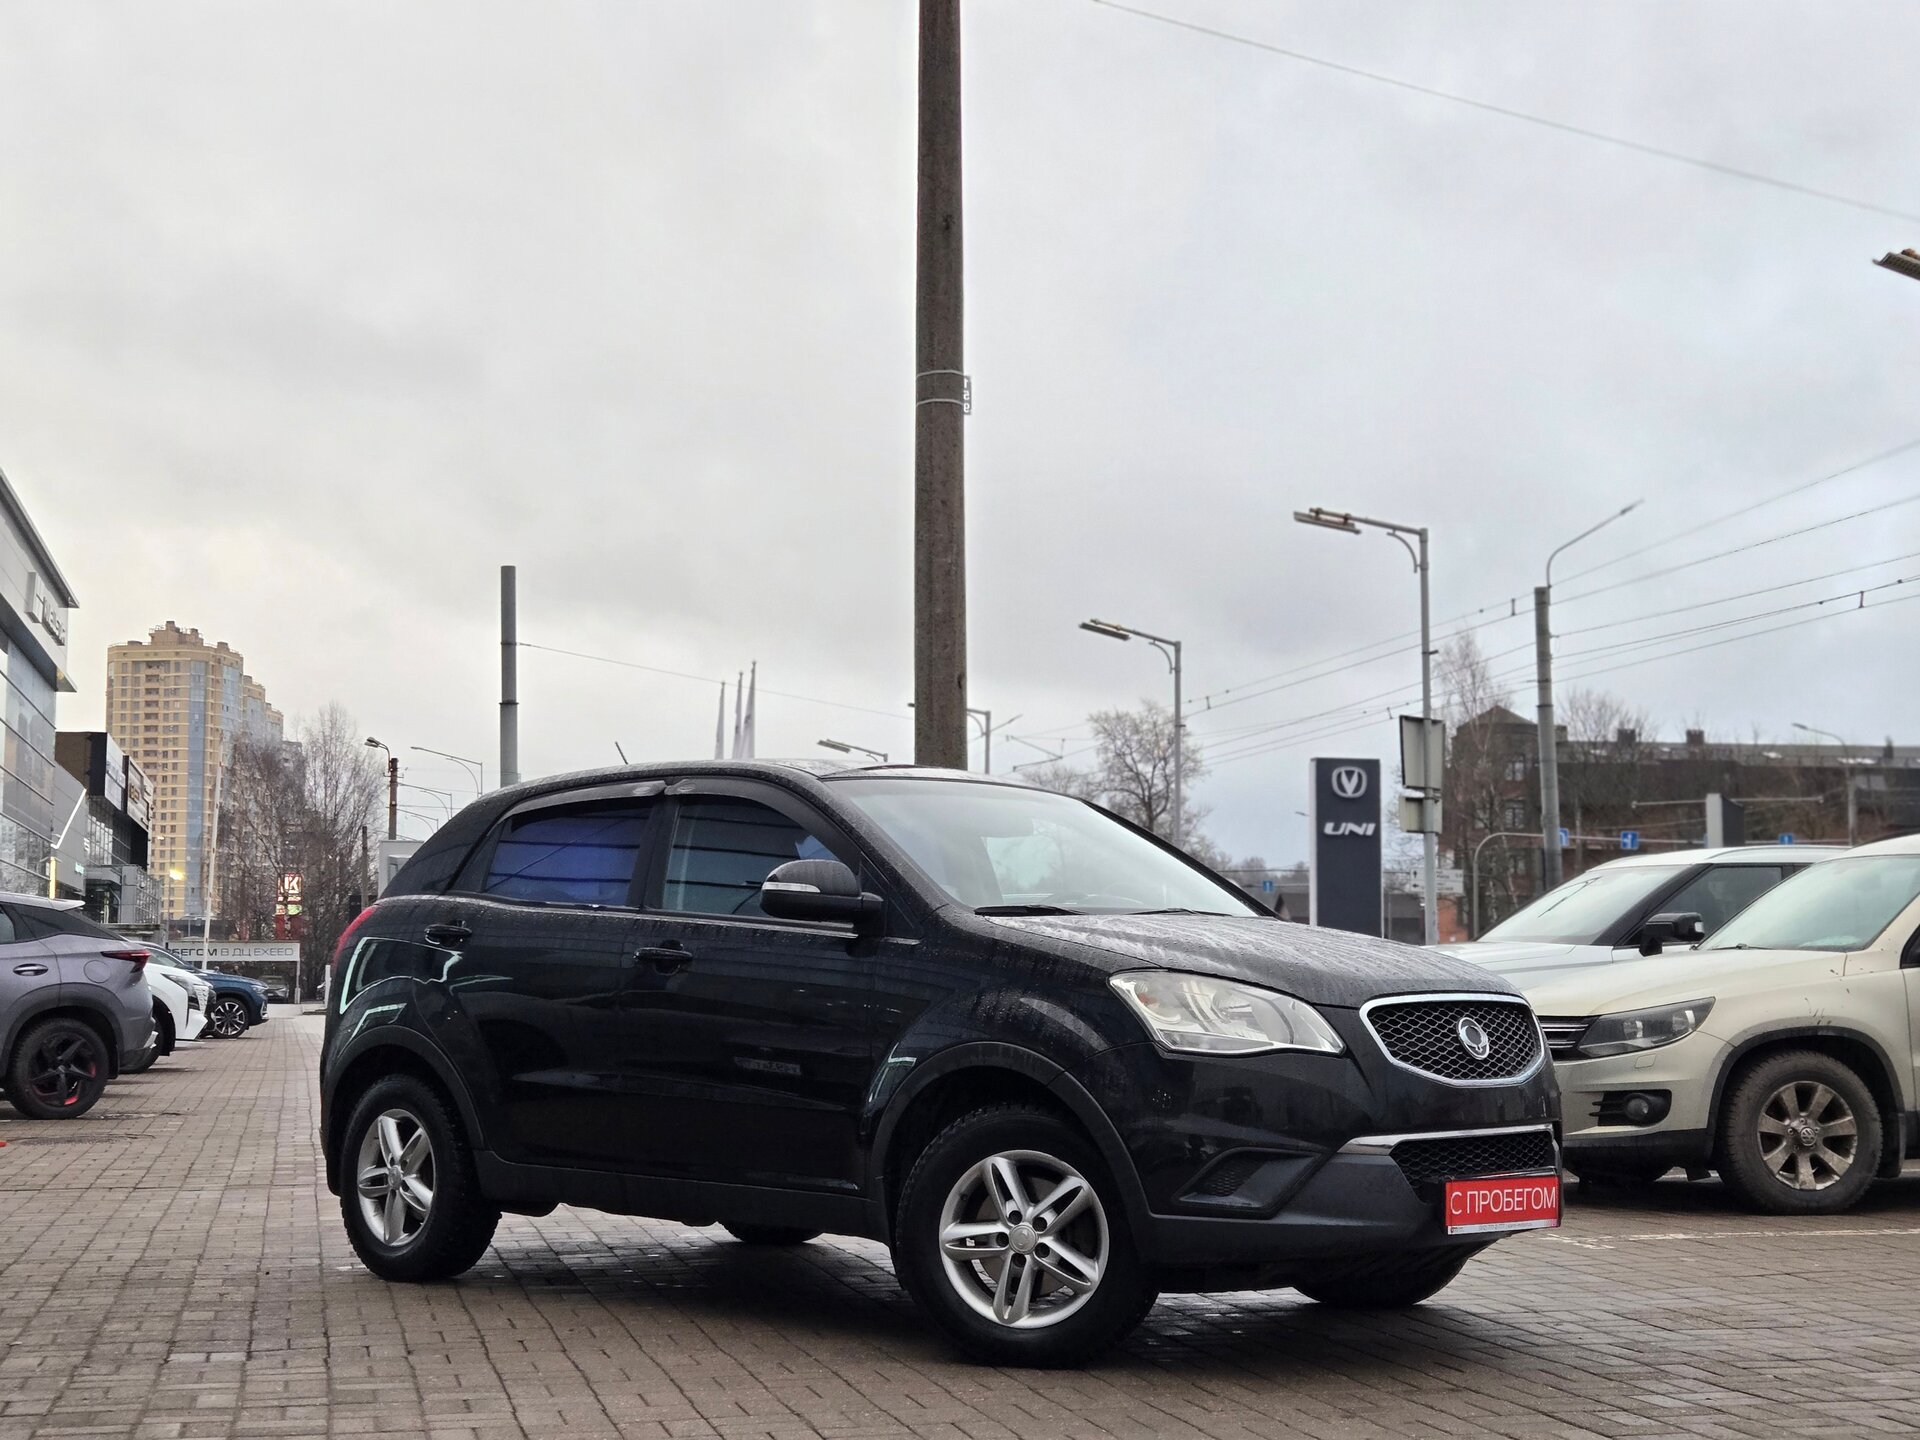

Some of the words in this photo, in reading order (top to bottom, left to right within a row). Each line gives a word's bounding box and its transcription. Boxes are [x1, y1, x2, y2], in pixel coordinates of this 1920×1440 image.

[1323, 822, 1376, 836] UNI
[168, 948, 217, 957] БЕГОМ
[254, 947, 294, 957] EXEED
[1450, 1191, 1462, 1215] С
[1466, 1186, 1556, 1214] ПРОБЕГОМ
